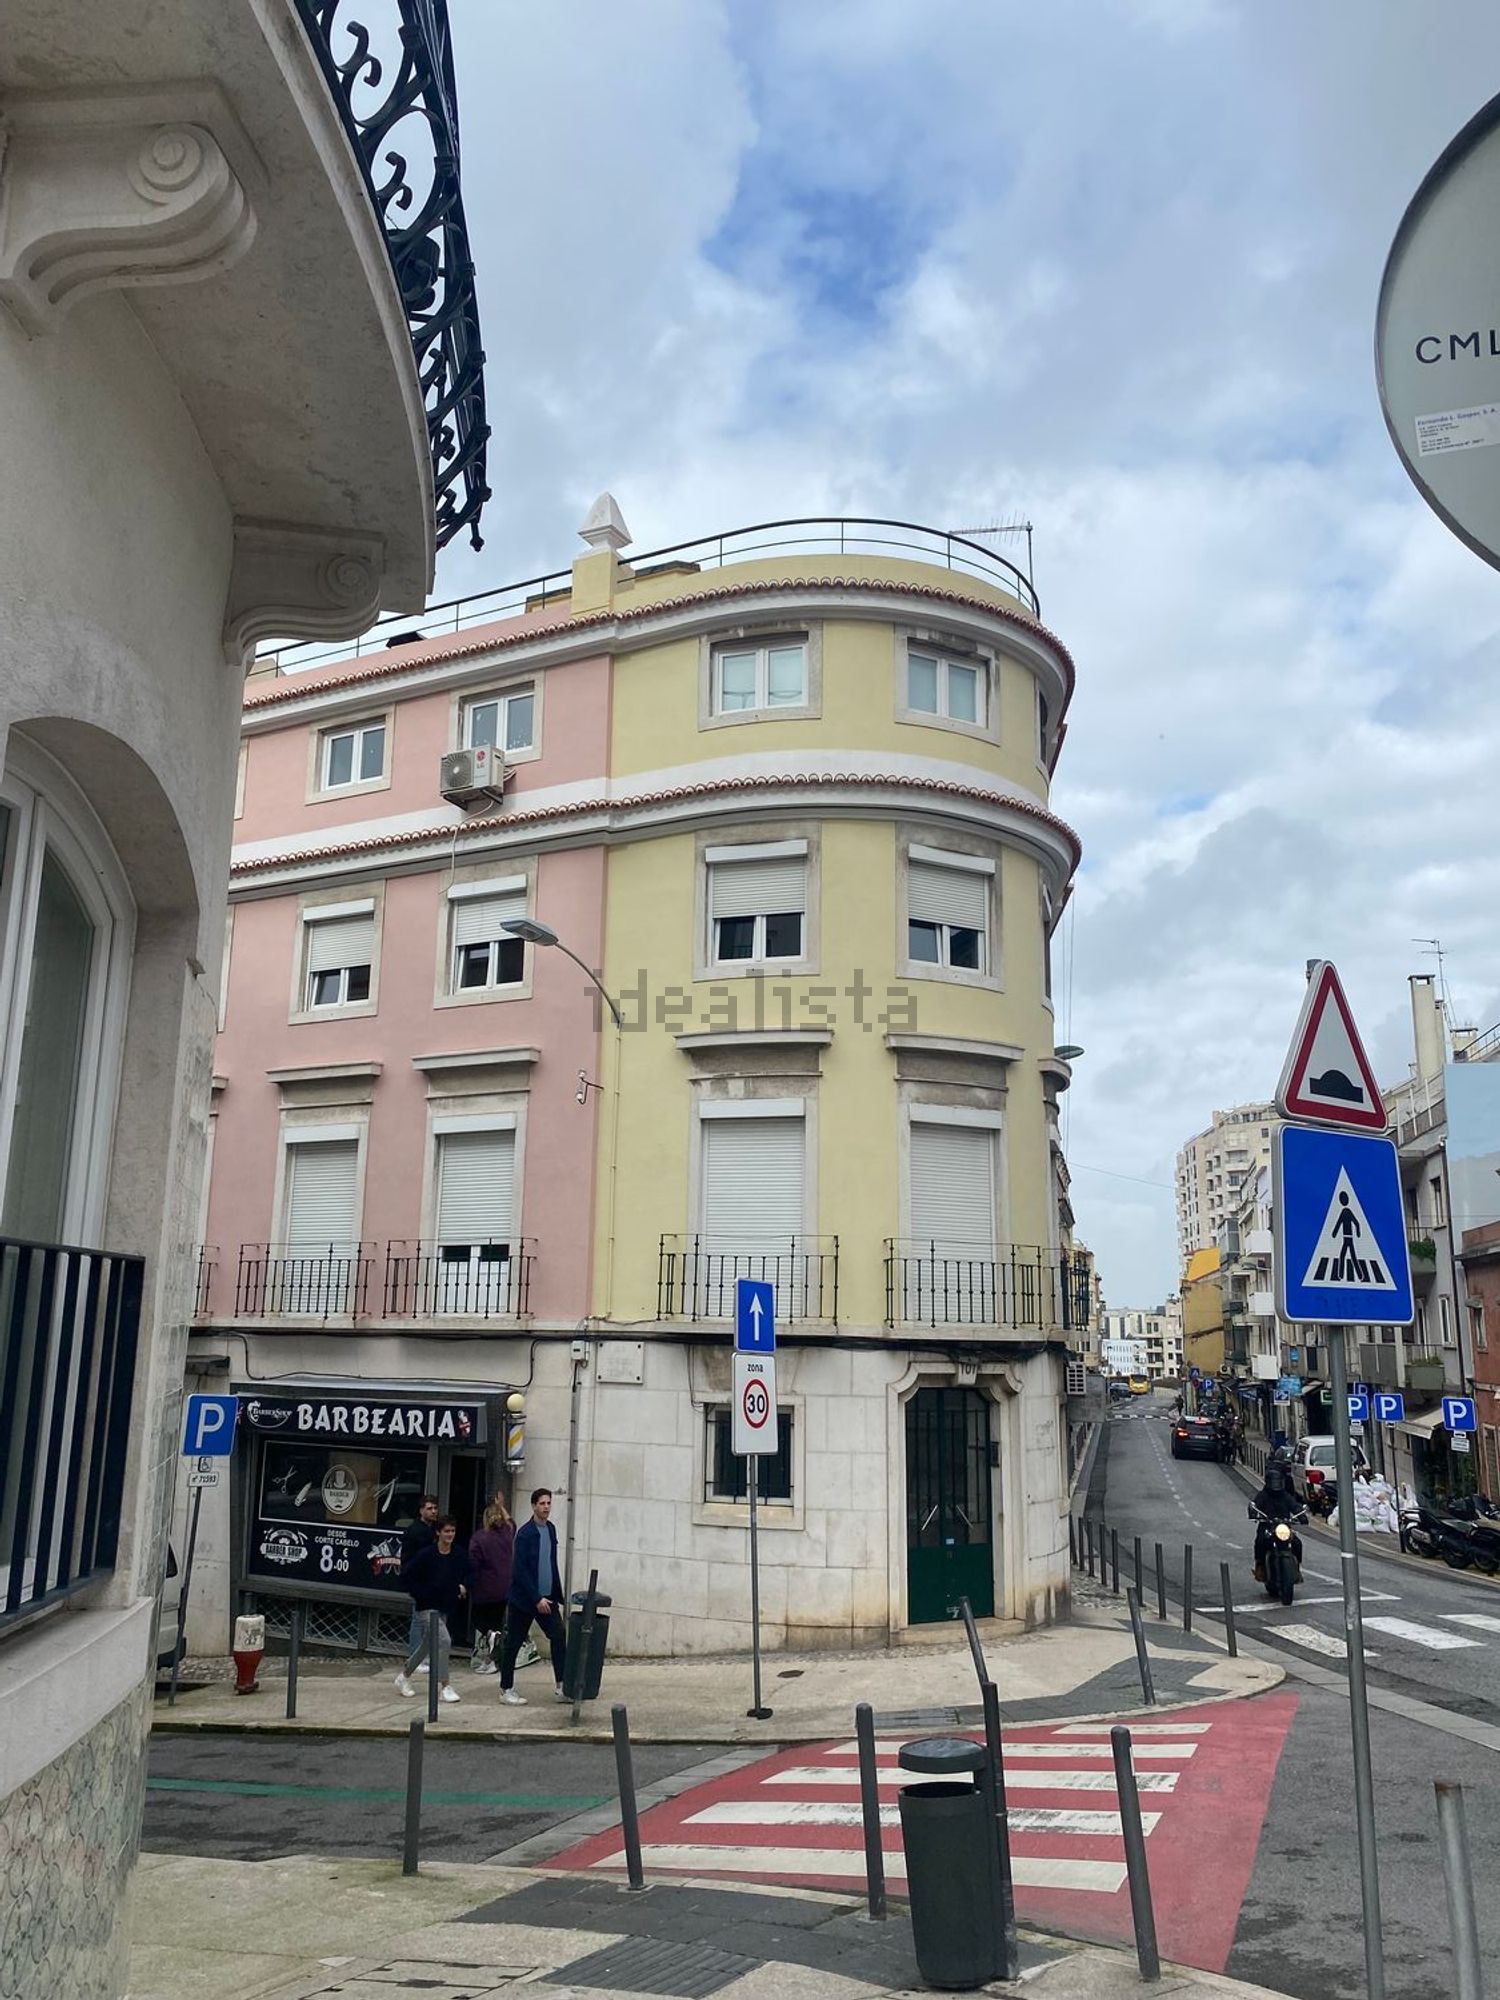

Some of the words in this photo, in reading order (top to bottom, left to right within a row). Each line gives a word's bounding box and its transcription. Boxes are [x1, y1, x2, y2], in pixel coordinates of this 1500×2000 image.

[1415, 329, 1500, 364] CML
[747, 1363, 764, 1373] zona
[747, 1394, 766, 1415] 30
[1348, 1397, 1363, 1418] P
[1380, 1396, 1397, 1418] P
[1448, 1400, 1468, 1428] P
[195, 1402, 226, 1449] P
[297, 1403, 456, 1438] BARBEARIA
[314, 1536, 334, 1545] CORTE
[335, 1538, 360, 1547] CABELO
[327, 1529, 347, 1538] DESDE
